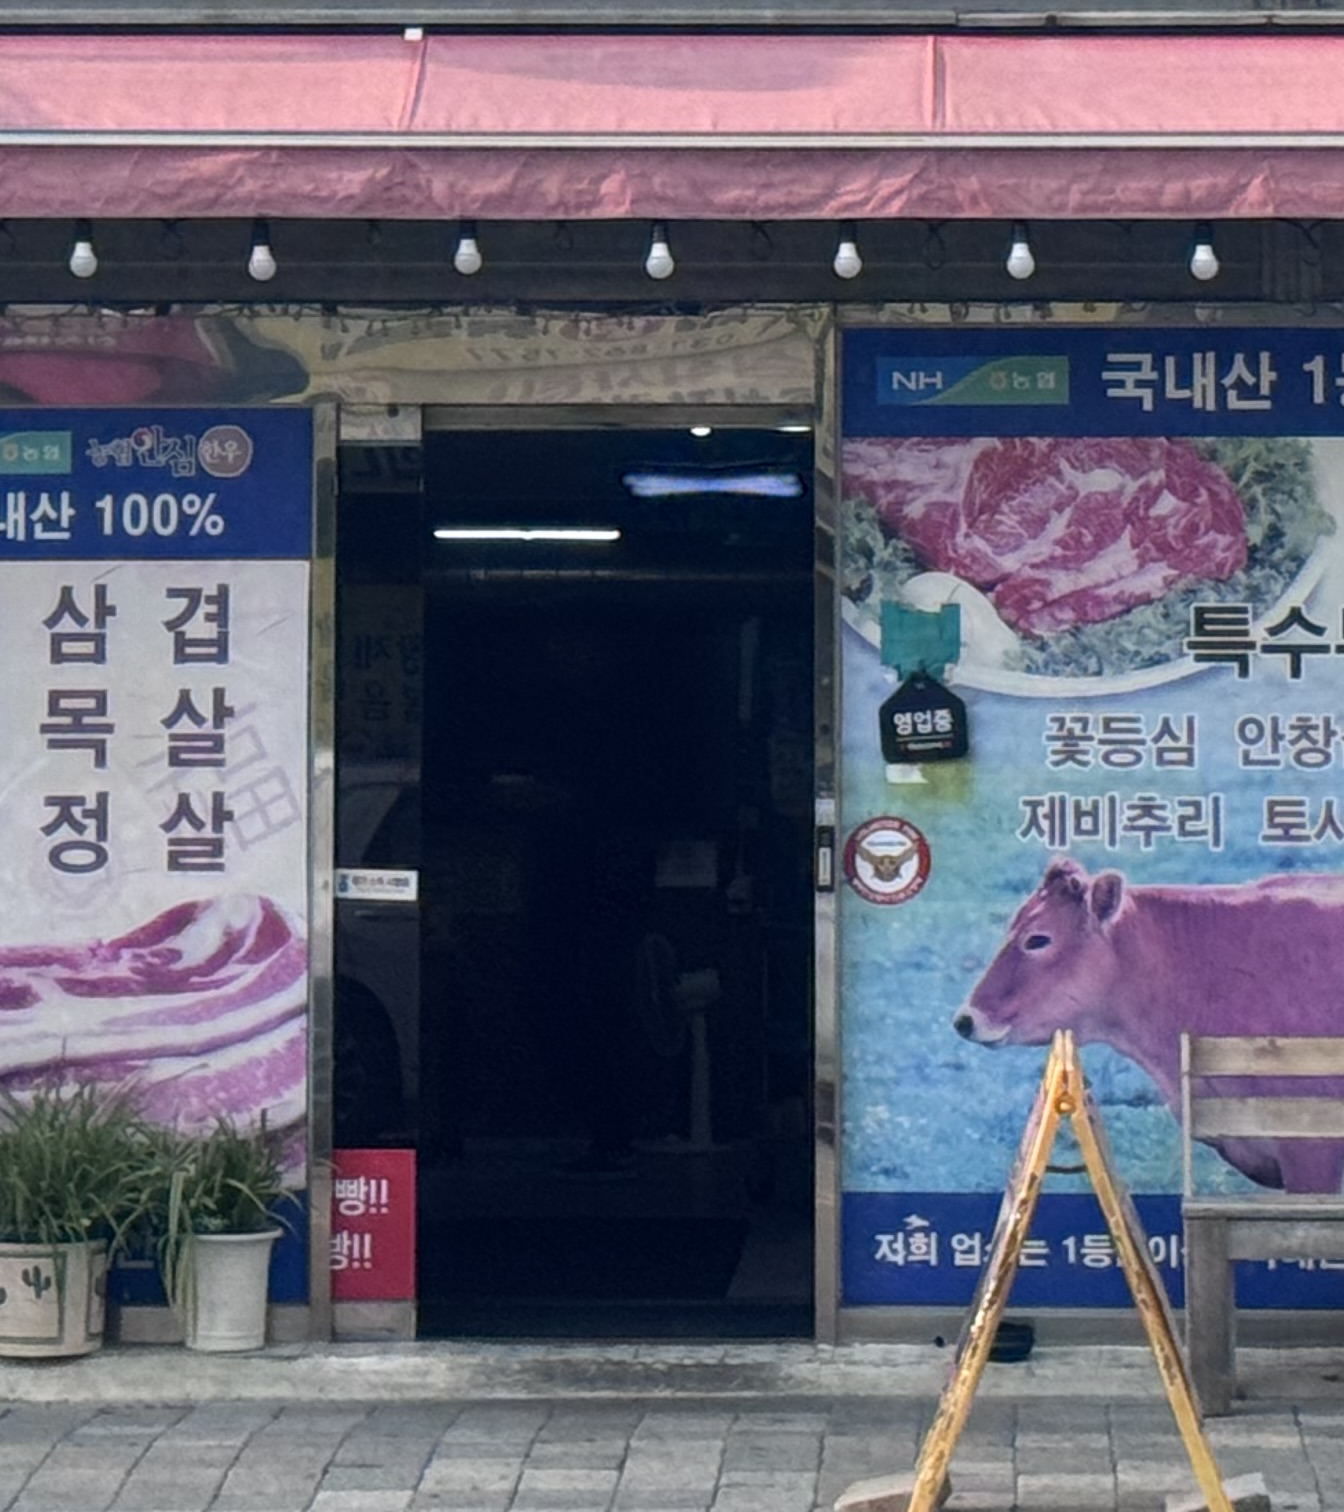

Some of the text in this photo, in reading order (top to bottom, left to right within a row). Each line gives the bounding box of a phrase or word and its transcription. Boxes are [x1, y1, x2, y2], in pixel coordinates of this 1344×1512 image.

[892, 370, 944, 391] NH
[1102, 351, 1278, 413] 국내산
[95, 492, 225, 537] 100%
[892, 707, 955, 736] 영업중
[1044, 714, 1199, 770] 꽃등심
[1019, 794, 1225, 852] 제비추리
[873, 1231, 938, 1267] 저희
[950, 1231, 1051, 1268] 업는
